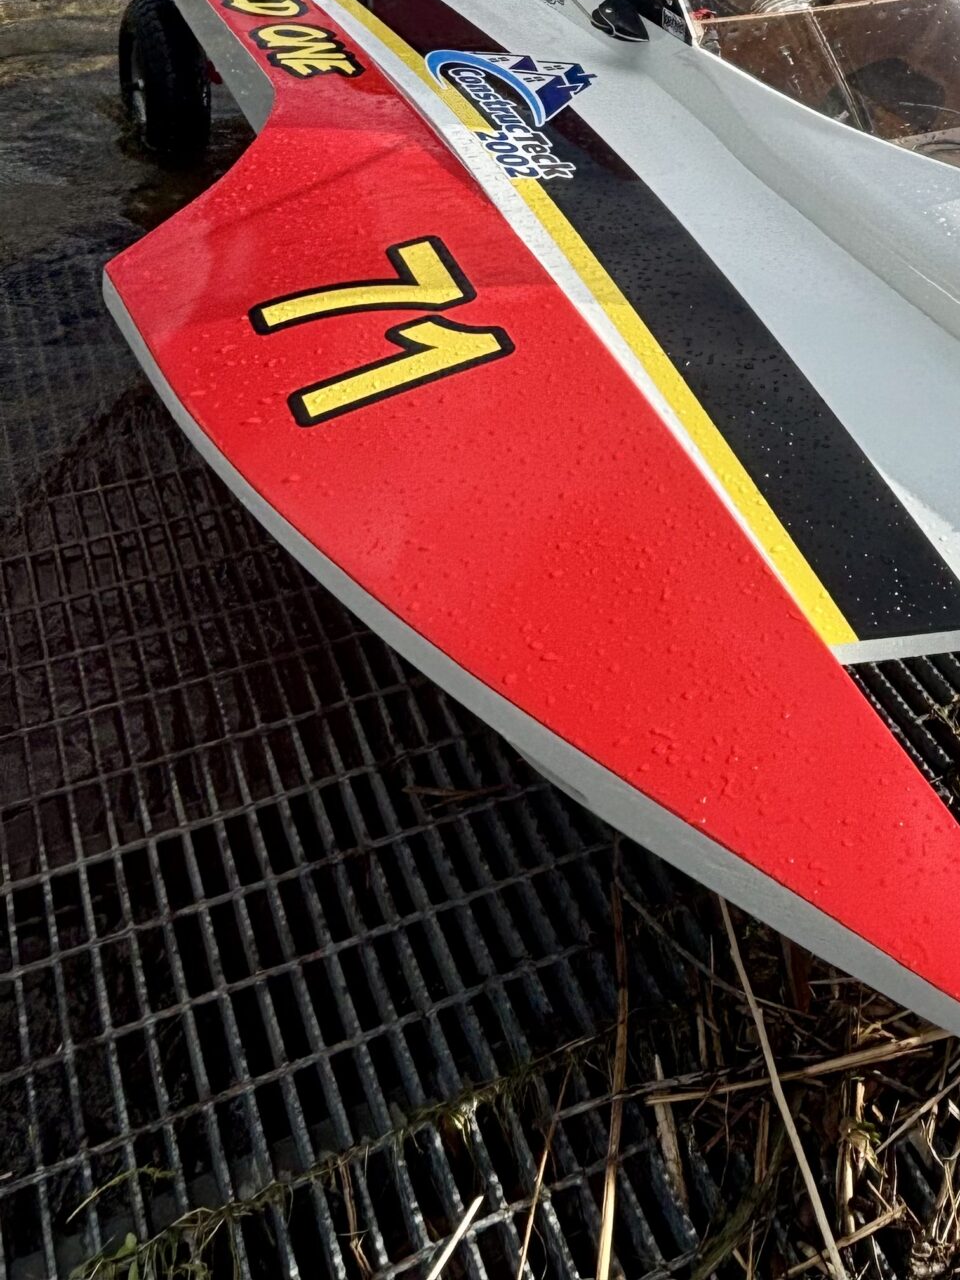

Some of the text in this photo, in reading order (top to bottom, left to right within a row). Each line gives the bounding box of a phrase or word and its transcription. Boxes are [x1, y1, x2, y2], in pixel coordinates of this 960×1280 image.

[250, 23, 366, 79] ONE
[473, 131, 540, 178] 2002
[248, 235, 516, 428] 71
